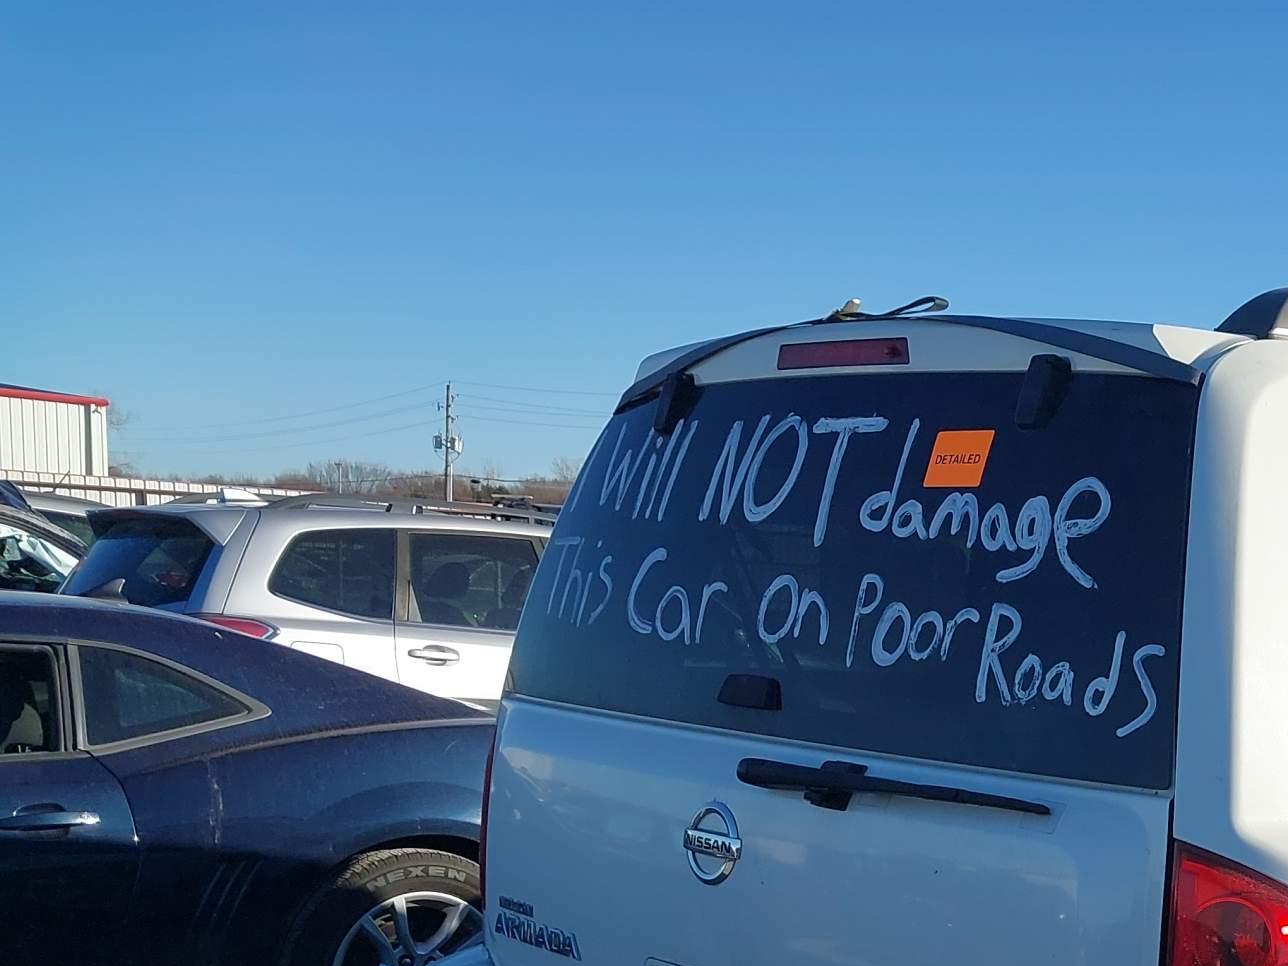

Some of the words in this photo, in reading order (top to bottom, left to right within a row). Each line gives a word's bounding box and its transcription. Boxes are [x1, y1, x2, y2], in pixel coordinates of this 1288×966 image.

[935, 453, 981, 465] DETAILED
[599, 417, 699, 522] Will
[698, 411, 889, 547] NOT
[859, 417, 1112, 590] damage
[547, 535, 613, 628] This
[627, 547, 728, 645] Car
[758, 574, 830, 646] On
[846, 572, 981, 668] Poor
[975, 602, 1166, 738] Roads
[685, 832, 732, 855] NISSAN
[366, 865, 466, 893] NEXEN
[495, 910, 582, 961] ARMADA
